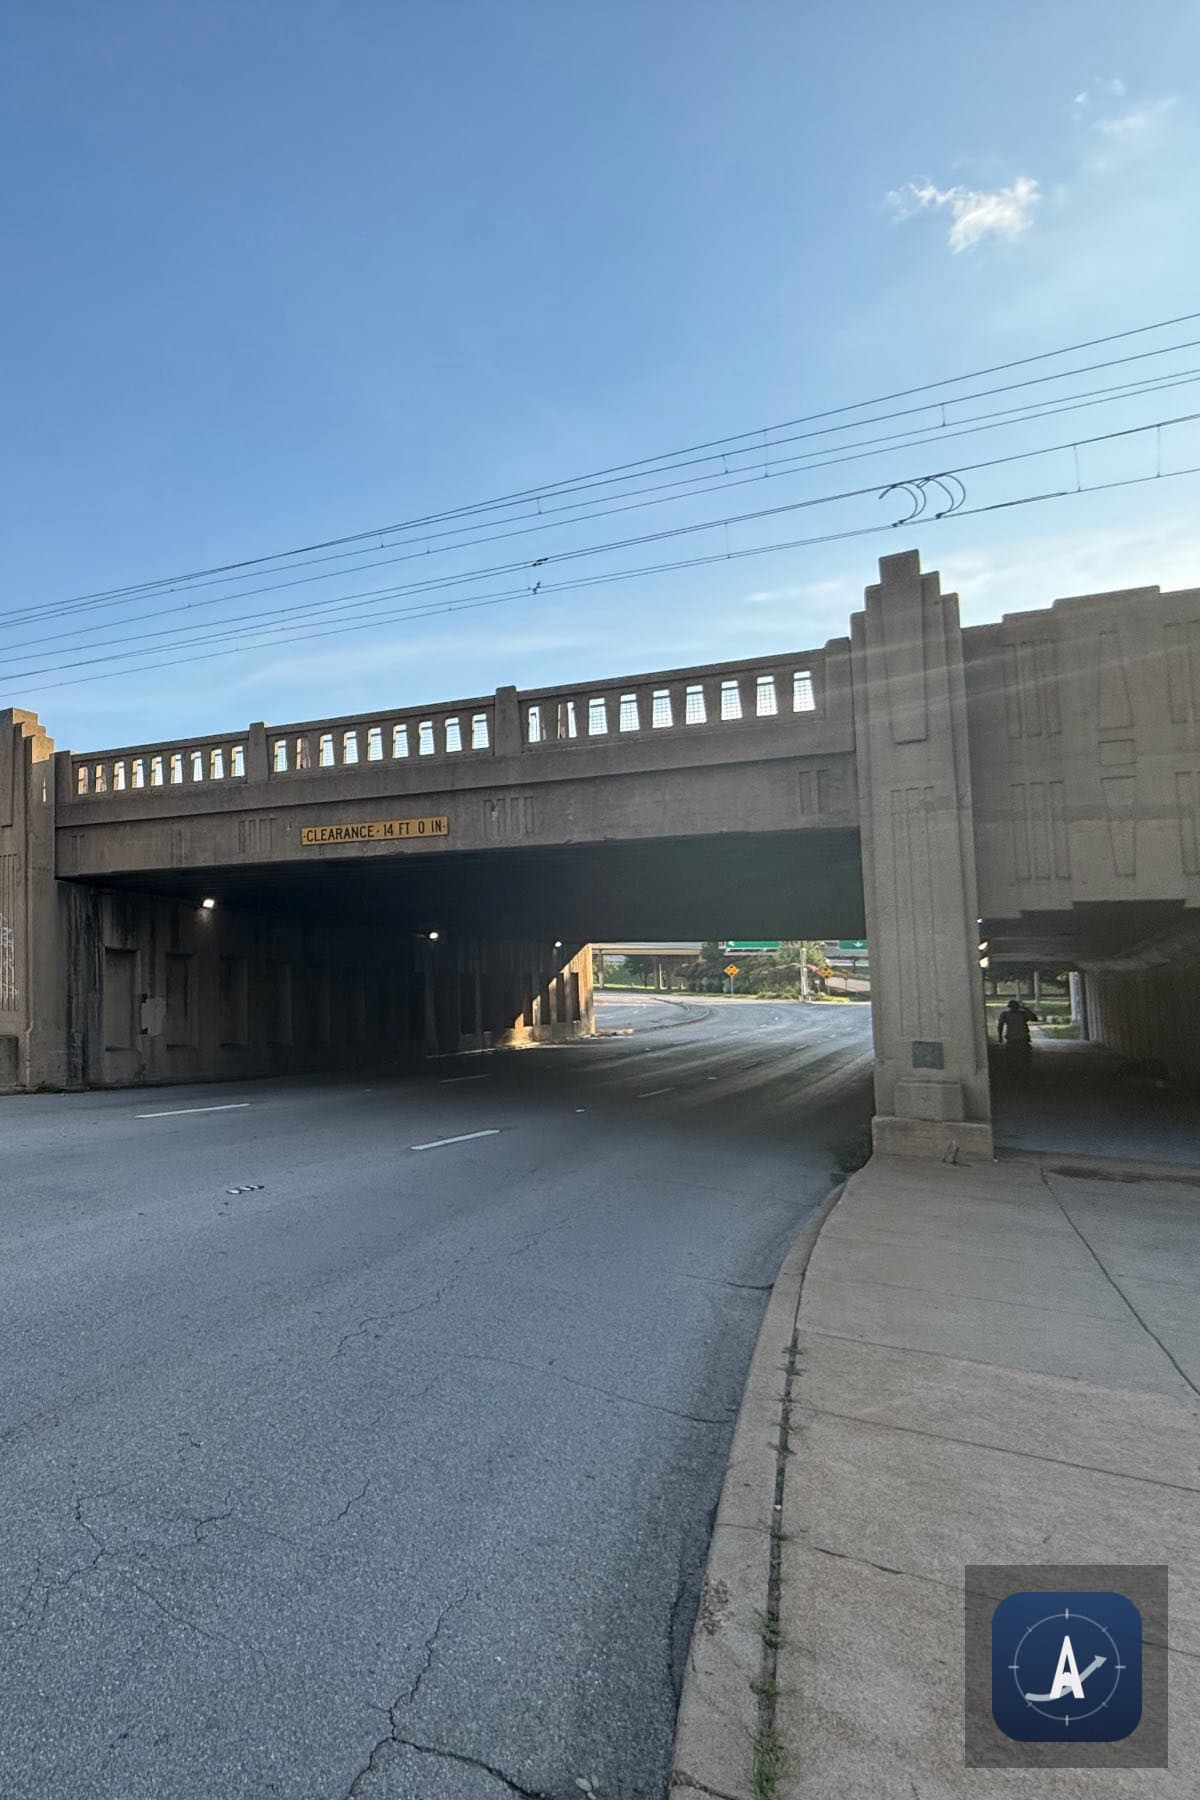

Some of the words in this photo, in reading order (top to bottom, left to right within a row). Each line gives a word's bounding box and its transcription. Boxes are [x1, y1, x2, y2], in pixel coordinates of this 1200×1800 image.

[306, 824, 375, 842] CLEARANCE
[383, 823, 395, 837] 14
[399, 822, 411, 835] FT
[431, 819, 442, 833] IN
